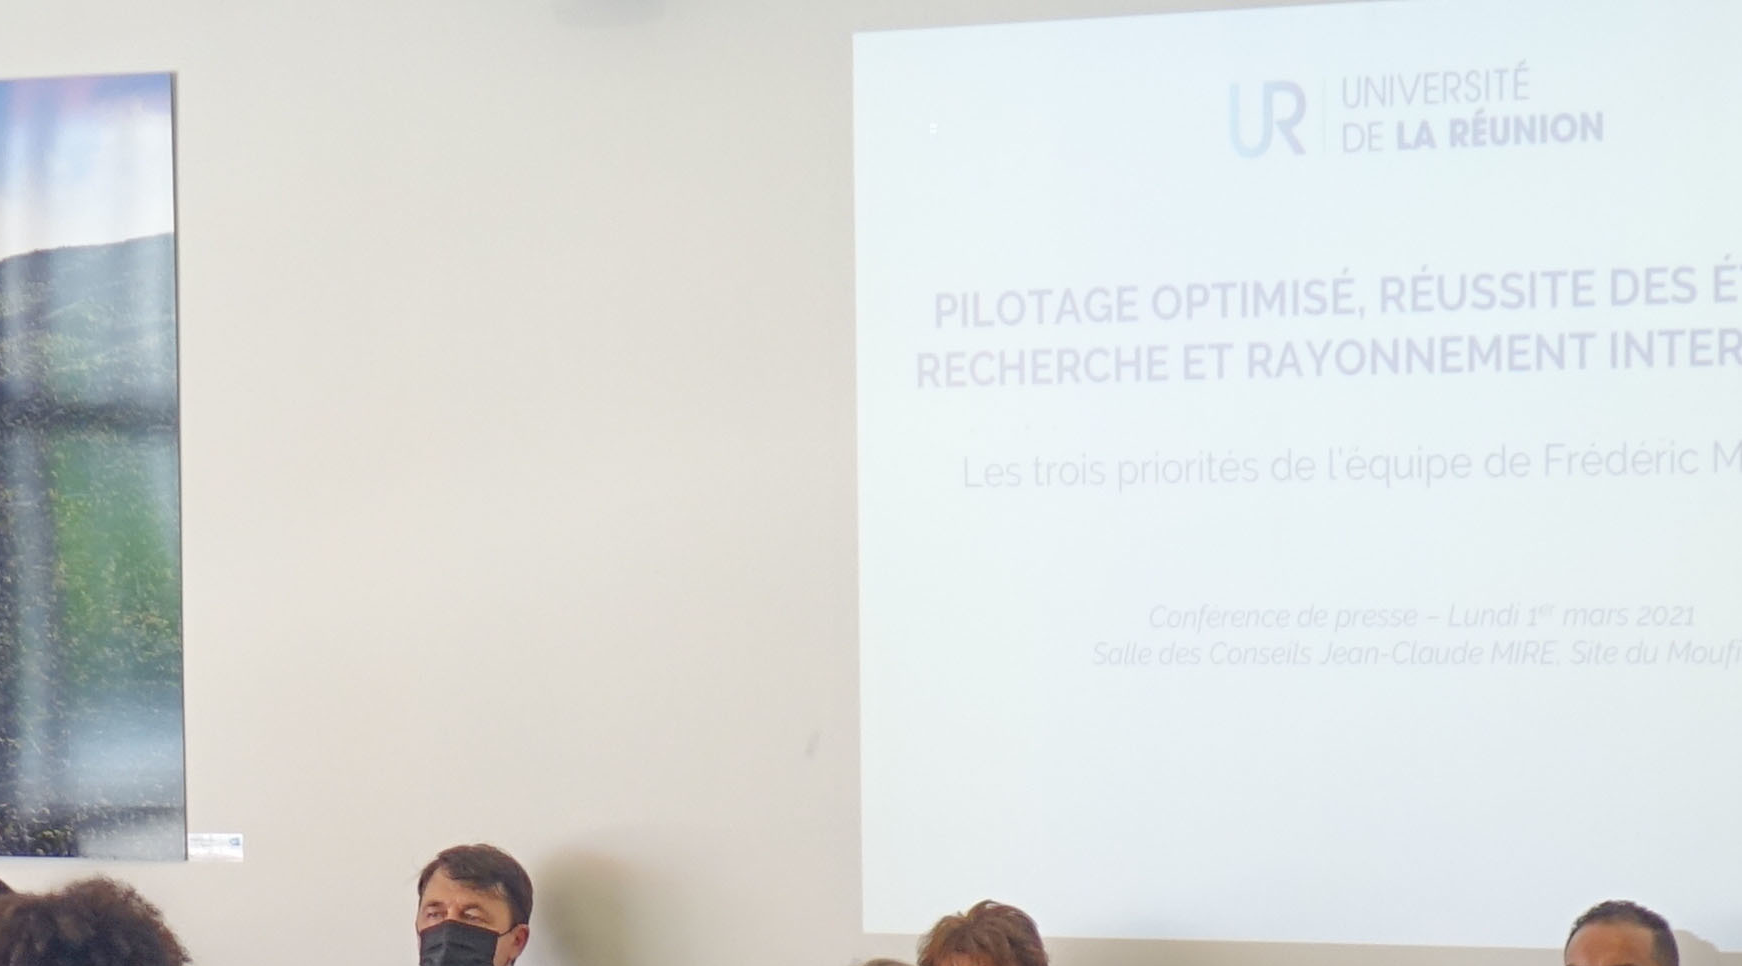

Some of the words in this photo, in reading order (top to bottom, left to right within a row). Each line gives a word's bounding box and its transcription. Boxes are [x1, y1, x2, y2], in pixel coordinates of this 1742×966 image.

[1341, 59, 1531, 109] UNIVERSITÉ
[1228, 80, 1307, 159] UR
[1341, 121, 1384, 154] DE
[1396, 120, 1438, 151] LA
[1448, 107, 1604, 148] RÉUNION
[935, 285, 1139, 329] PILOTAGE
[1151, 267, 1365, 321] OPTIMISÉ,
[1379, 264, 1595, 313] RÉUSSITE
[1609, 265, 1698, 307] DES
[916, 344, 1169, 389] RECHERCHE
[1183, 343, 1234, 380] ET
[1247, 331, 1597, 380] RAYONNEMENT
[963, 454, 1021, 489] Les
[1033, 452, 1107, 488] trois
[1117, 448, 1260, 495] priorités
[1270, 447, 1315, 482] de
[1326, 445, 1475, 488] l'équipe
[1483, 444, 1531, 479] de
[1543, 438, 1699, 477] Frédéric
[1148, 603, 1291, 634] Conférence
[1296, 603, 1329, 628] de
[1334, 607, 1419, 632] presse
[1448, 602, 1520, 627] Lundi
[1562, 607, 1630, 627] mars
[1637, 605, 1696, 627] 2021
[1093, 640, 1153, 666] Salle
[1158, 640, 1202, 666] des
[1209, 640, 1312, 666] Conseils
[1318, 639, 1484, 666] Jean-Claude
[1569, 639, 1617, 665] Site
[1626, 639, 1659, 665] du
